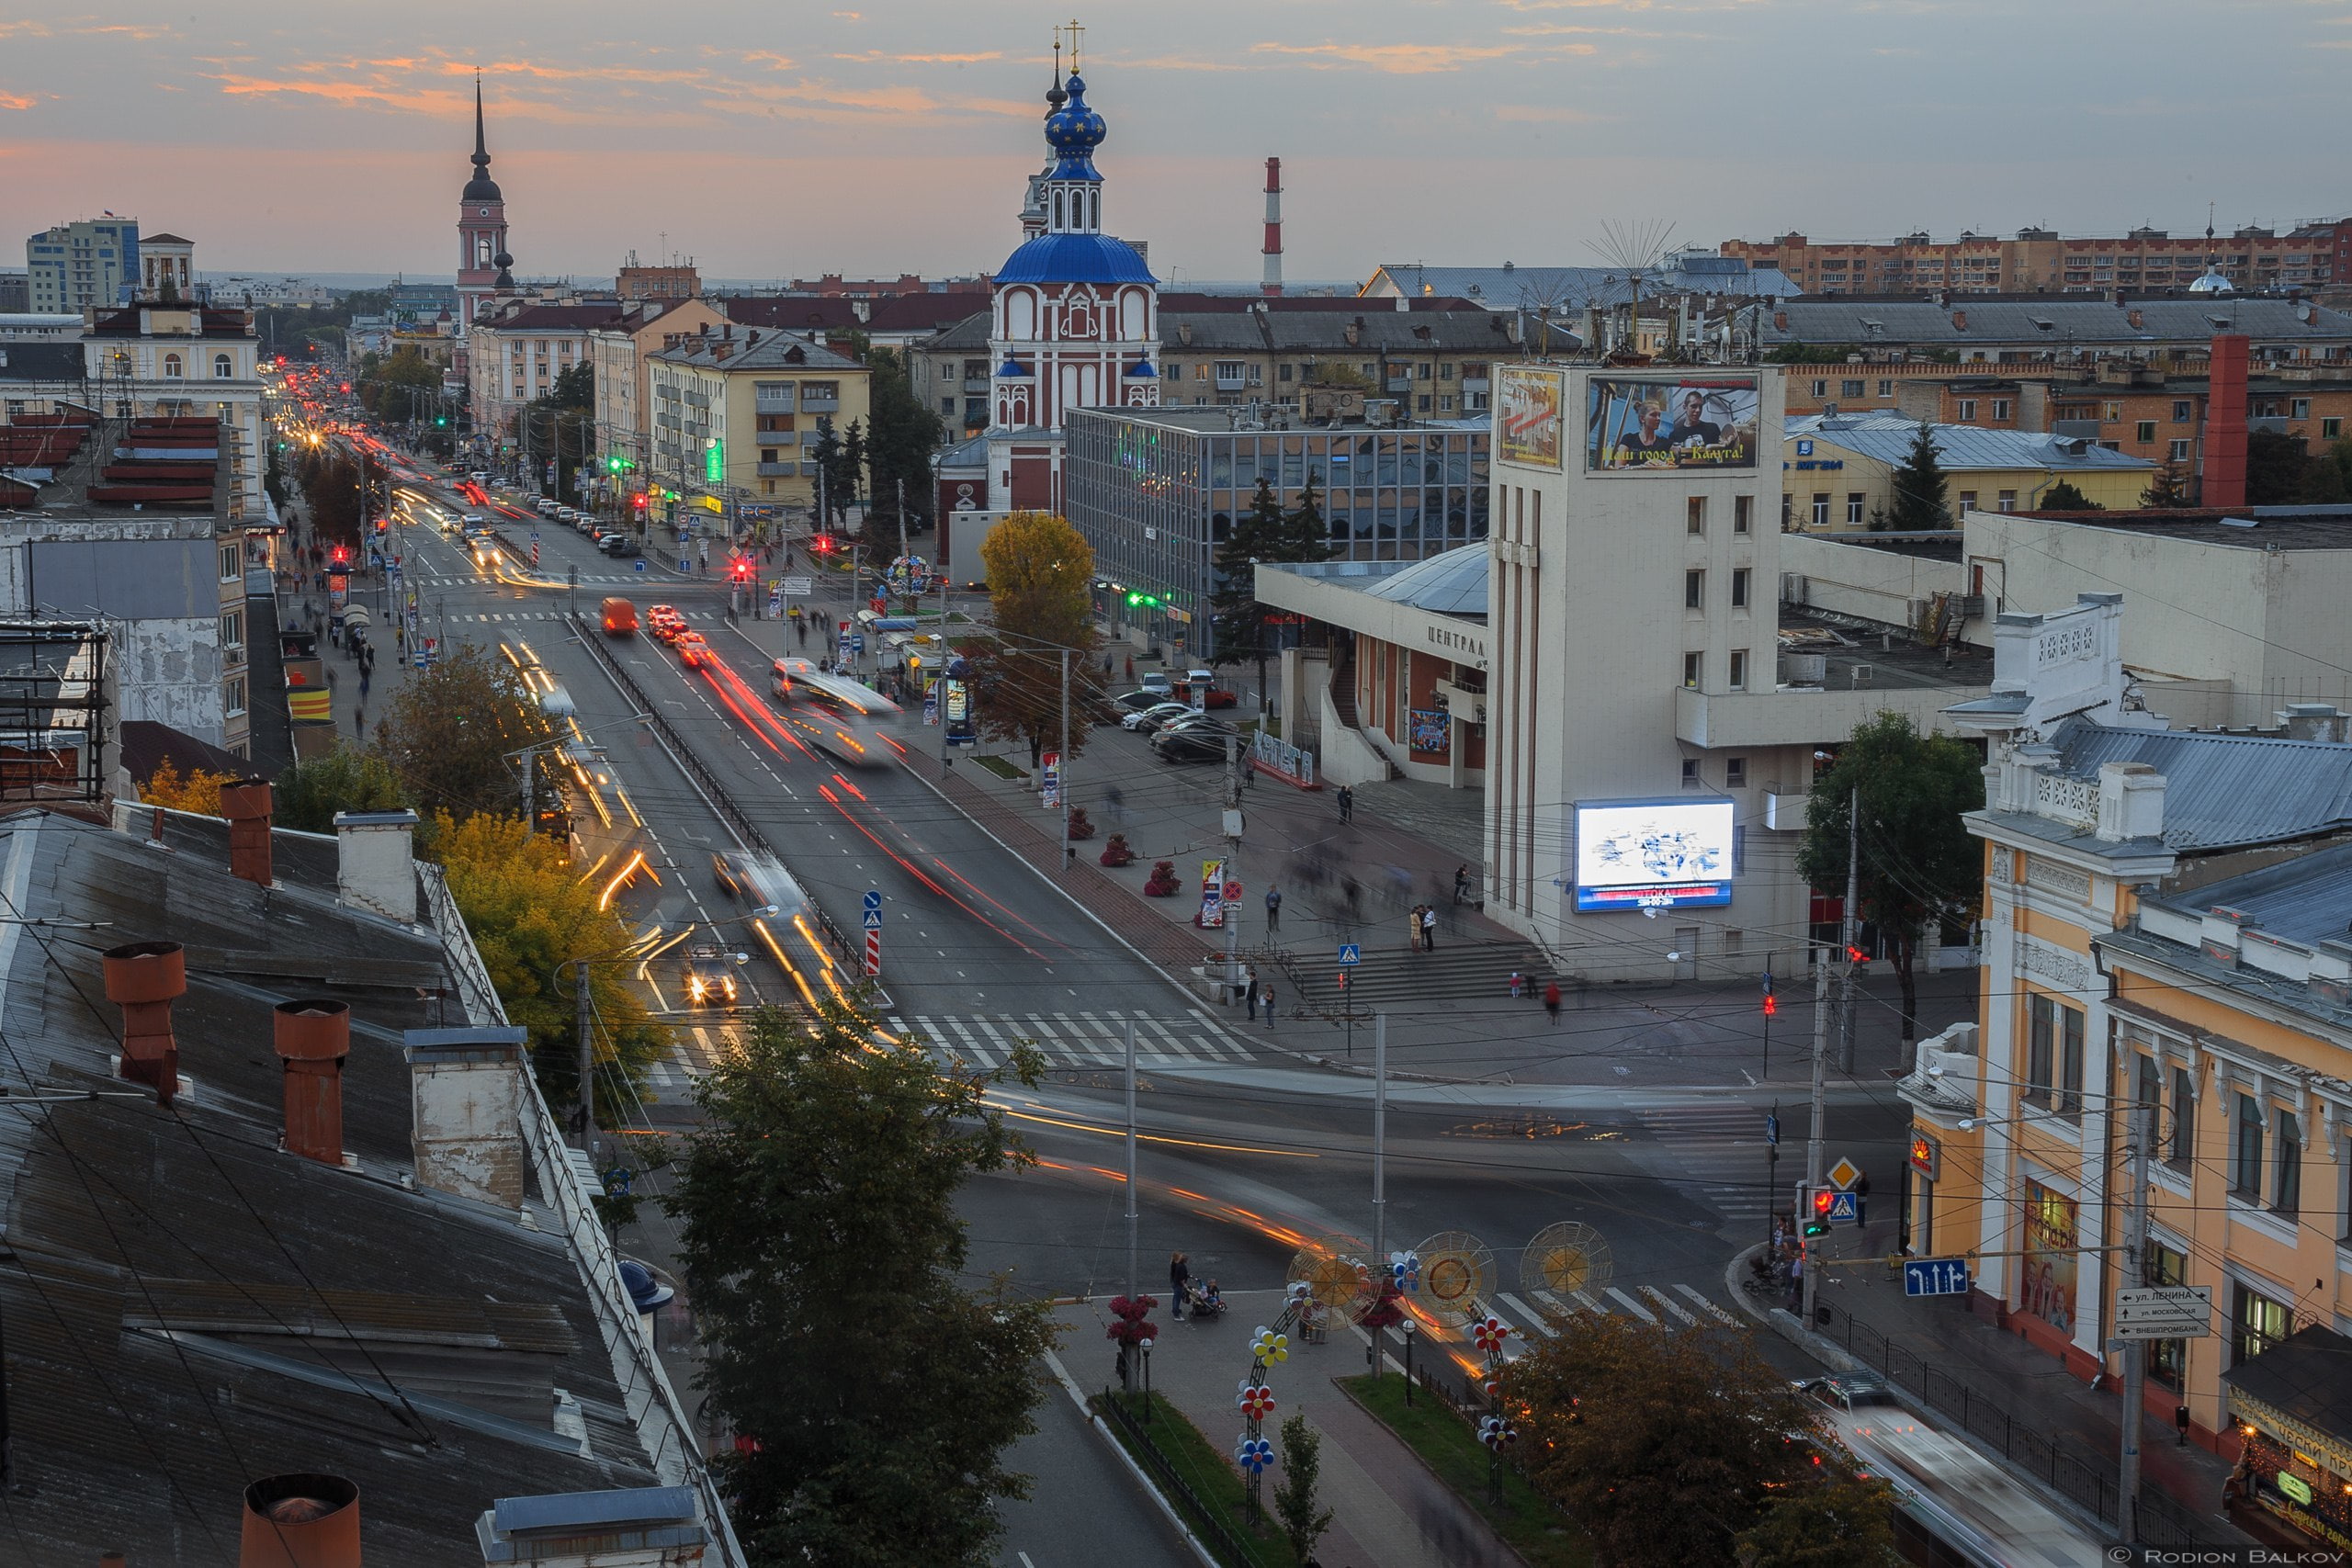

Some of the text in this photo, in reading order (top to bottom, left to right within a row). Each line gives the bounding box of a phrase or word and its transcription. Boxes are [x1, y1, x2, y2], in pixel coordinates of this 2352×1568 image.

[1602, 448, 1634, 461] Наш
[1639, 450, 1676, 463] город
[1691, 444, 1744, 463] Калуга!
[1254, 728, 1313, 785] КАЛУГА
[2135, 1291, 2192, 1303] ул. ЛЕНИНА
[2135, 1325, 2199, 1334] ВНЕШПРОМБАНК
[2278, 1426, 2322, 1461] ЧЕСКИ
